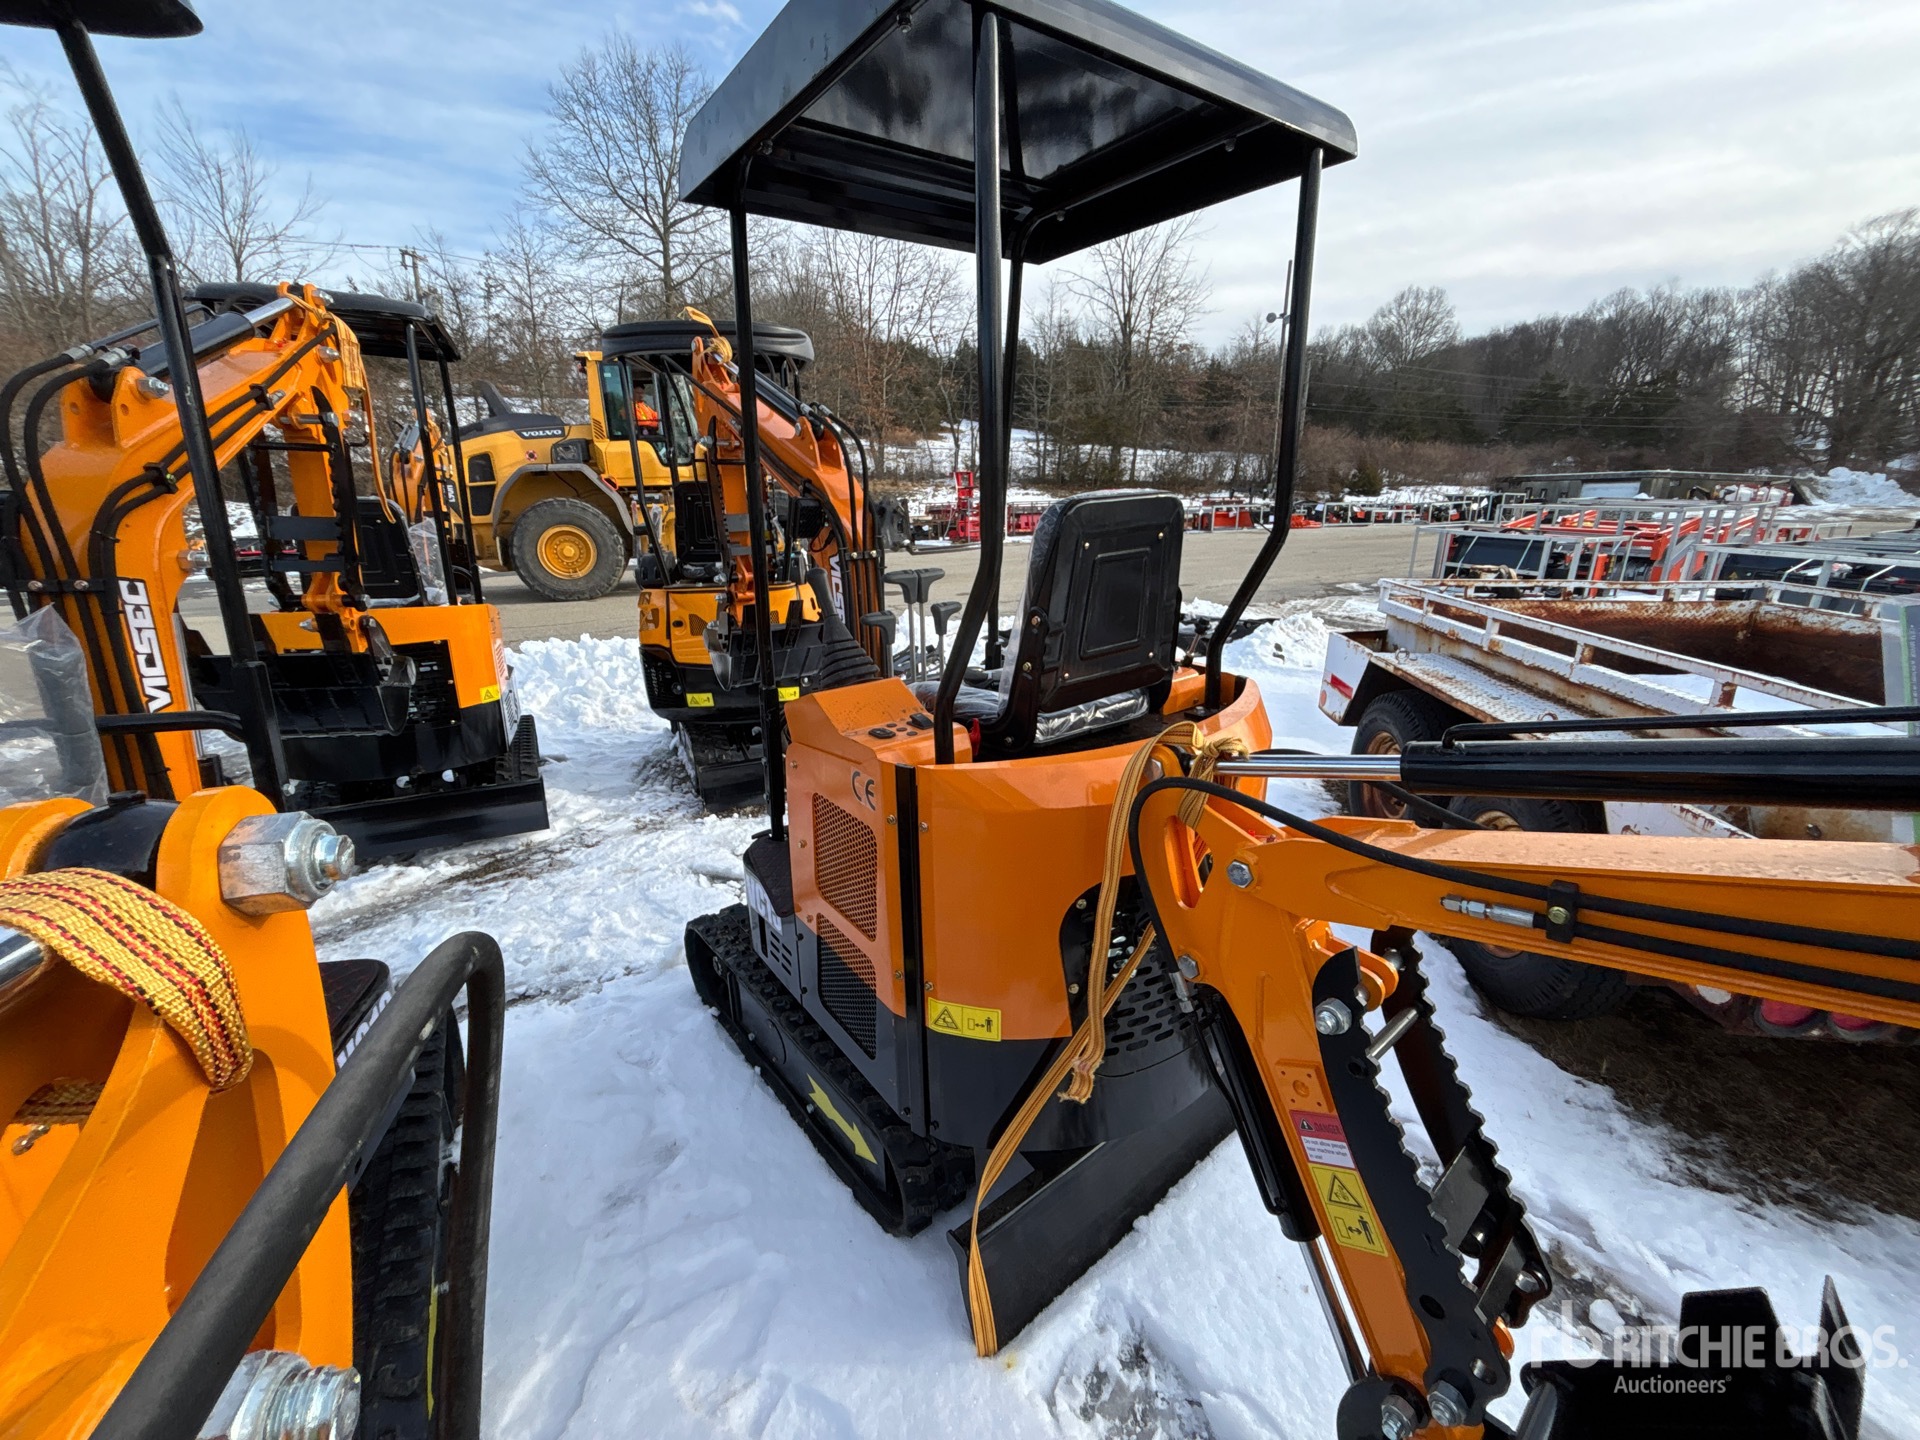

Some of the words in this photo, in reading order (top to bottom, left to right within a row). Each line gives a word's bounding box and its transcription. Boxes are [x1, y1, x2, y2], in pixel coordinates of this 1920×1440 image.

[521, 429, 562, 437] VOLVO
[118, 580, 172, 713] VICSEC
[852, 771, 876, 811] CE
[1313, 1122, 1342, 1135] DANGER
